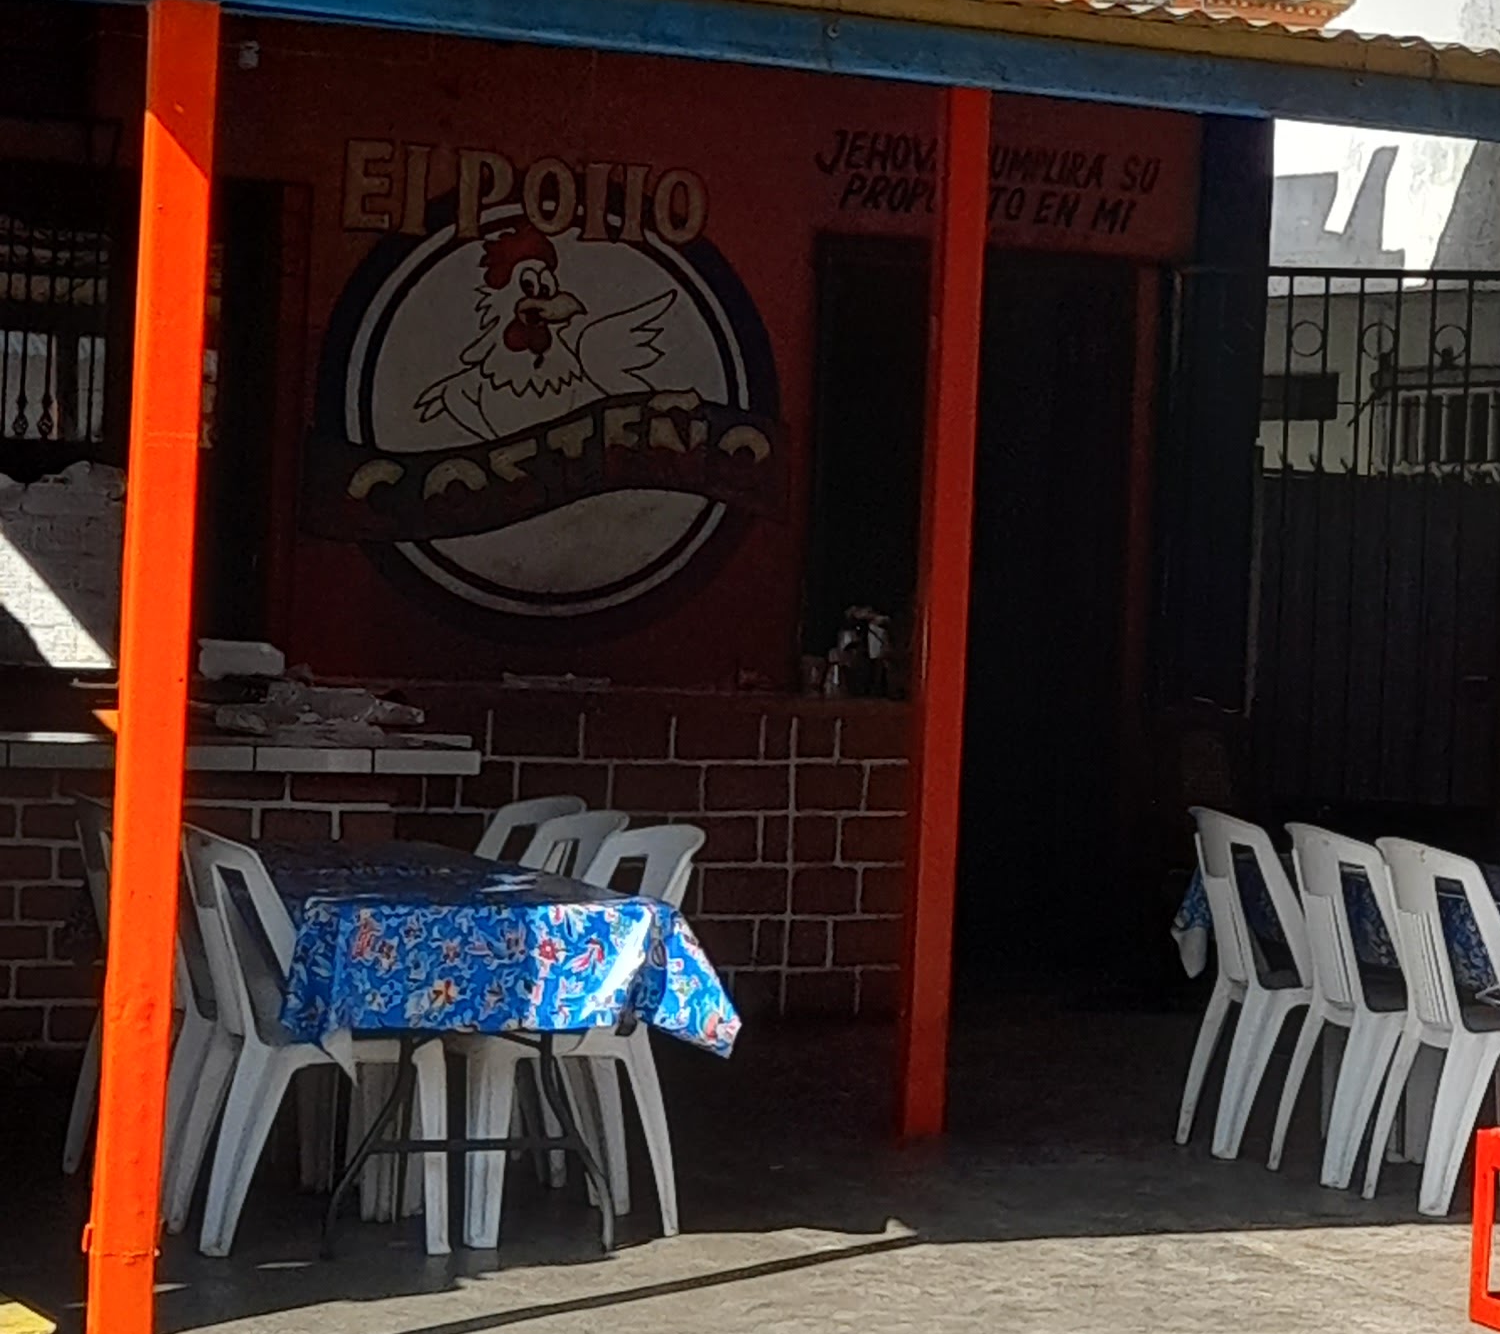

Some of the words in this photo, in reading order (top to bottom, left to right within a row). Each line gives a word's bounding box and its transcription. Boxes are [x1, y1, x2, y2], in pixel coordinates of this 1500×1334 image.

[815, 129, 938, 176] JEHOV
[988, 144, 1106, 190] UMPLIRA
[1121, 154, 1162, 194] SU
